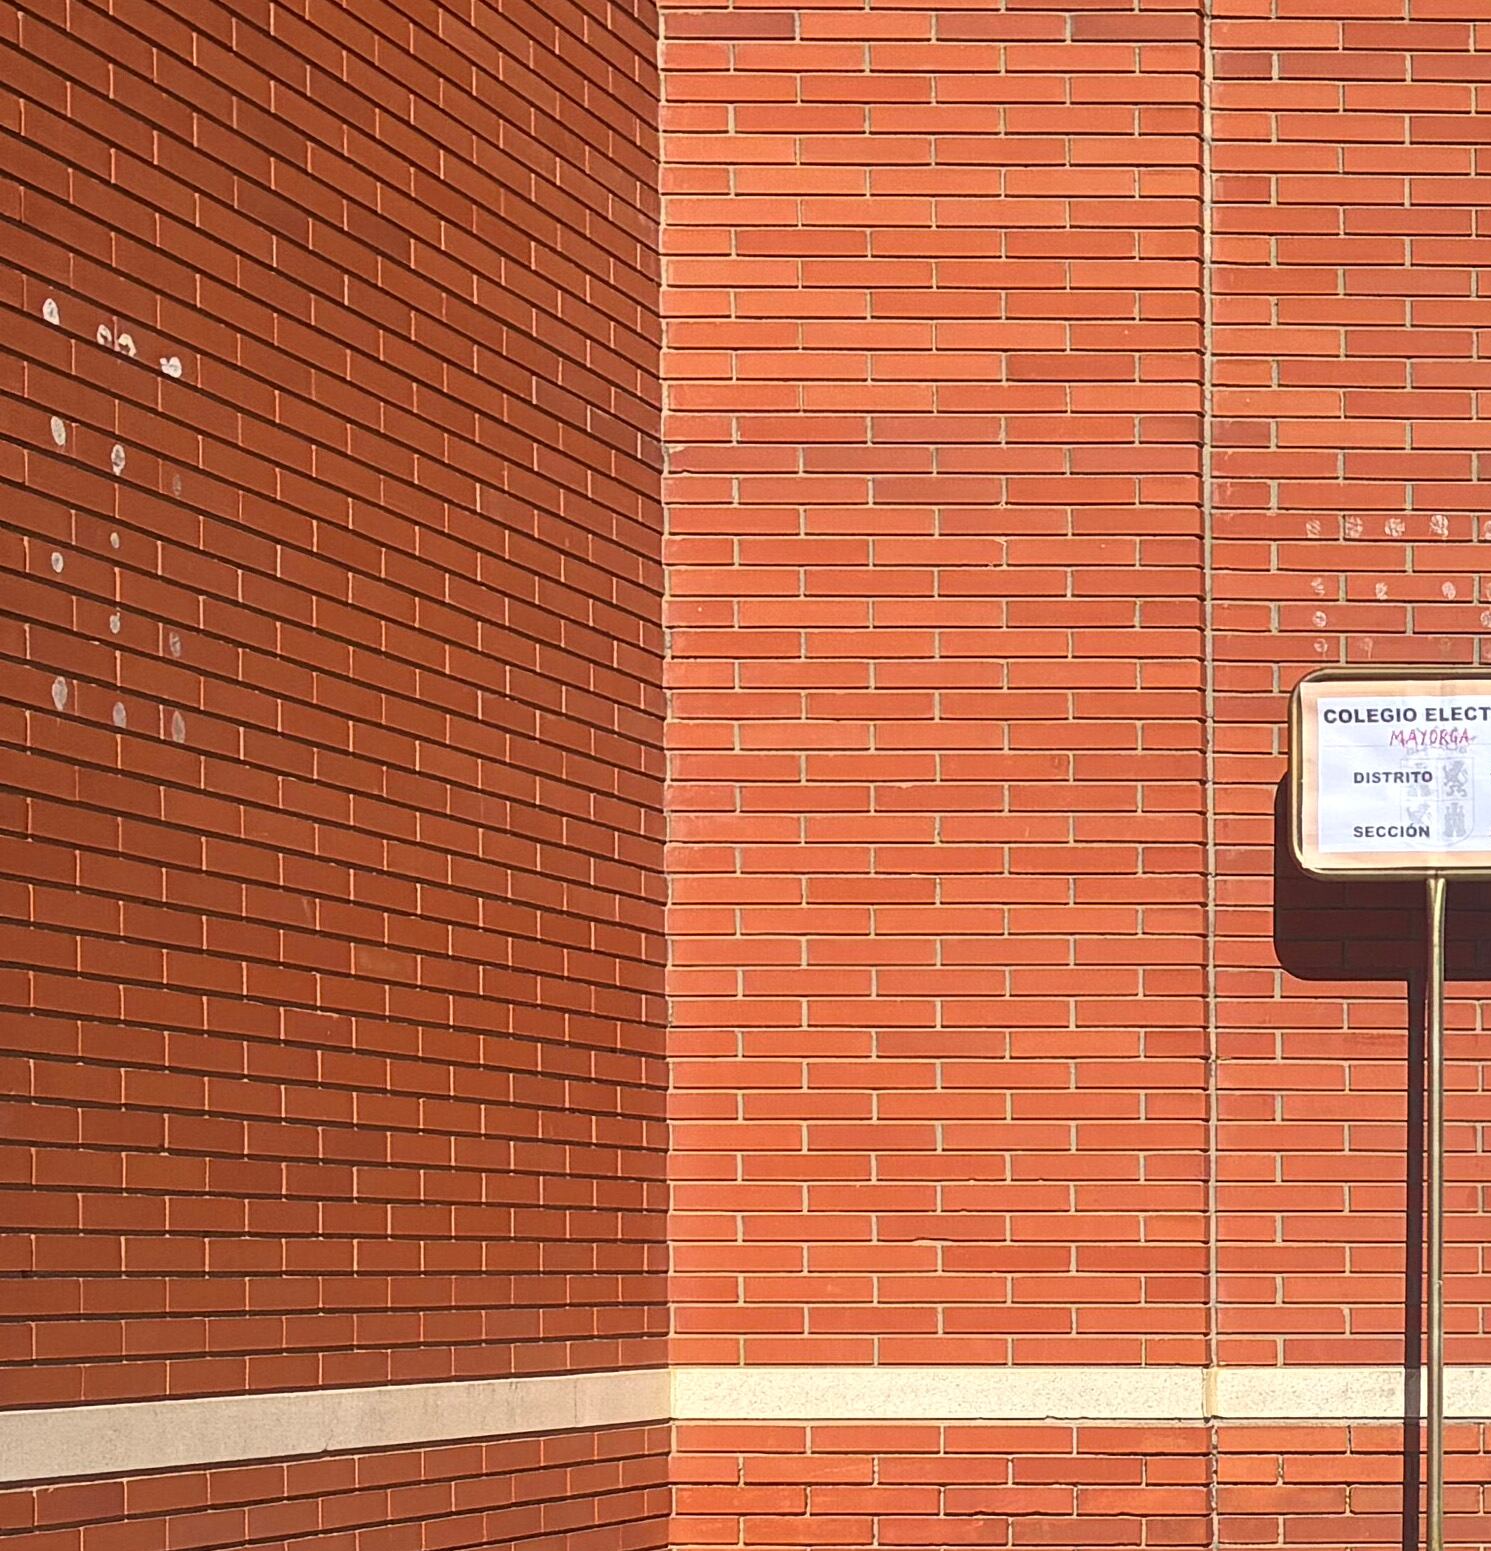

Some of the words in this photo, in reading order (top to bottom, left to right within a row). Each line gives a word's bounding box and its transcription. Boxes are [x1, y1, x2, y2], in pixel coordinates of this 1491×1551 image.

[1323, 707, 1417, 724] COLEGIO
[1389, 727, 1472, 747] MAYORGA
[1353, 770, 1433, 784] DISTRITO
[1353, 823, 1430, 838] SECCIÓN
